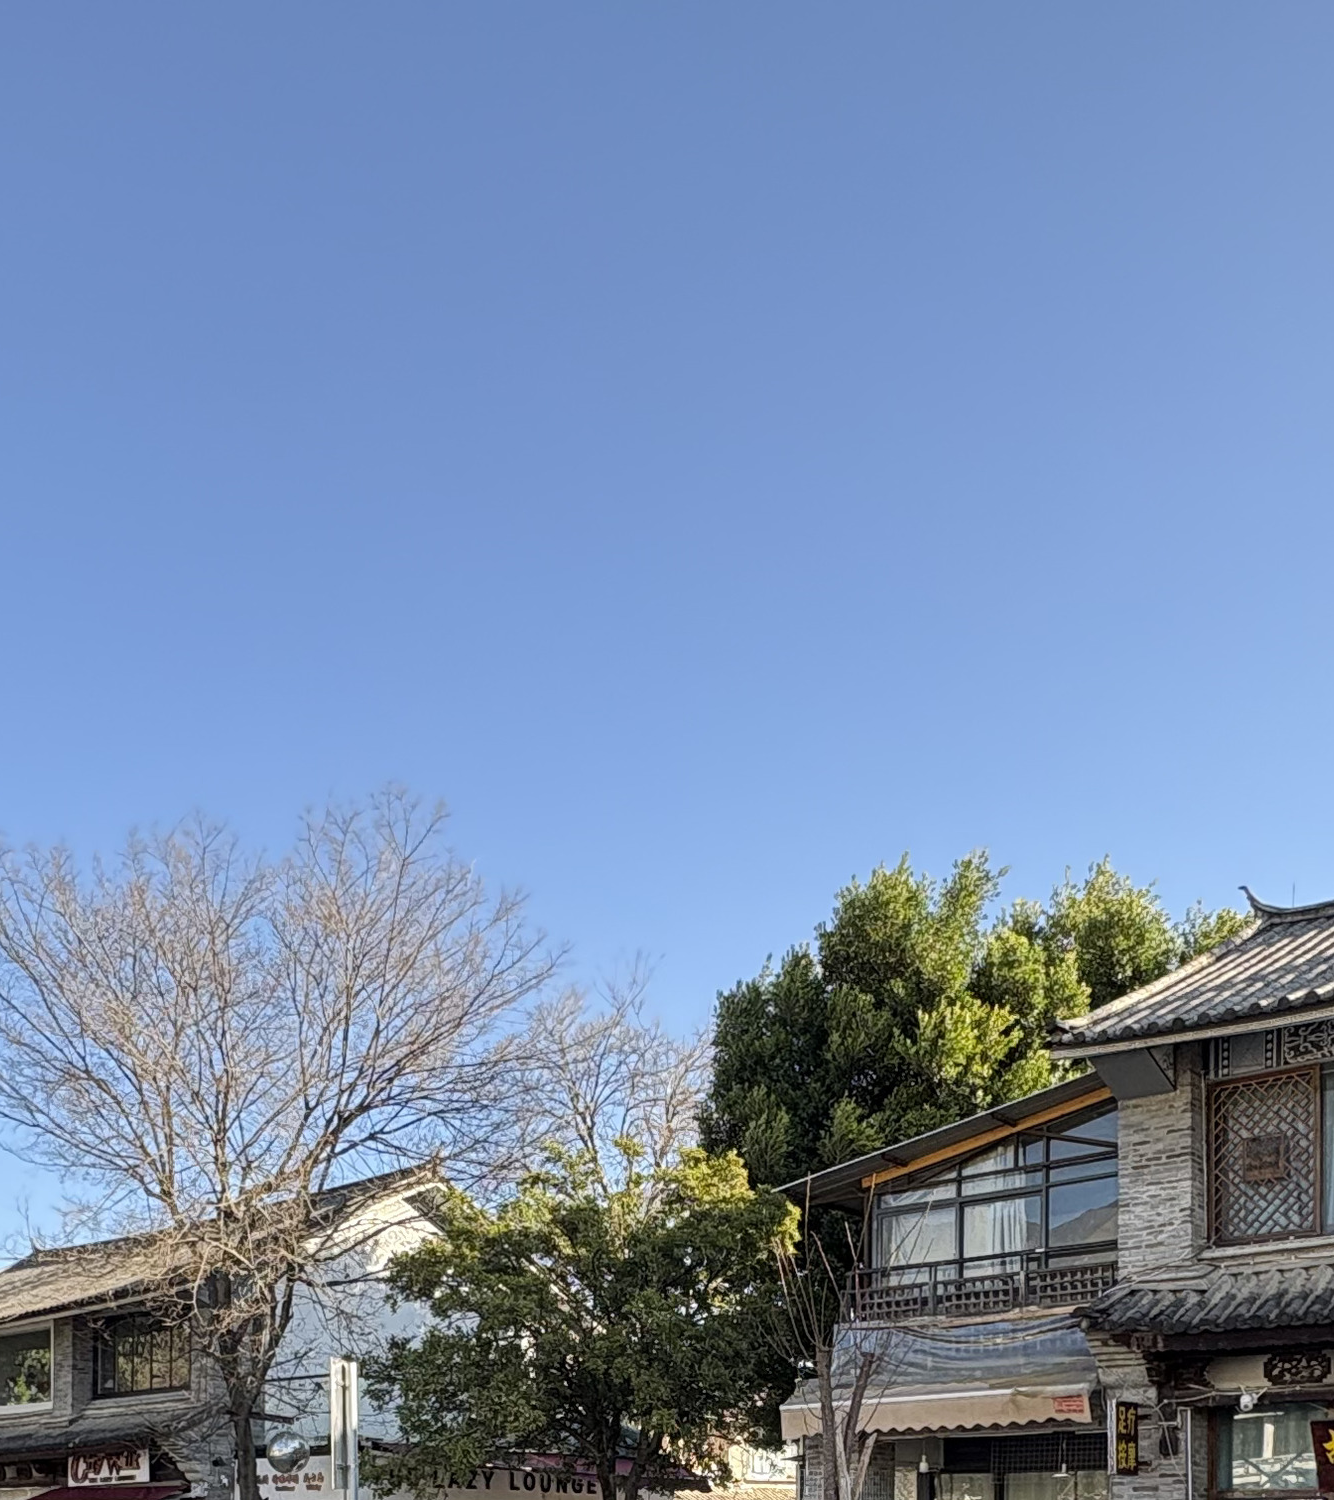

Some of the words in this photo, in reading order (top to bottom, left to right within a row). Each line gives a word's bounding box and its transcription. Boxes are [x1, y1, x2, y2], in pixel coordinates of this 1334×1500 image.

[1118, 1405, 1136, 1436] 足疗
[1118, 1440, 1136, 1470] 按摩
[510, 1470, 598, 1494] LOUNGE
